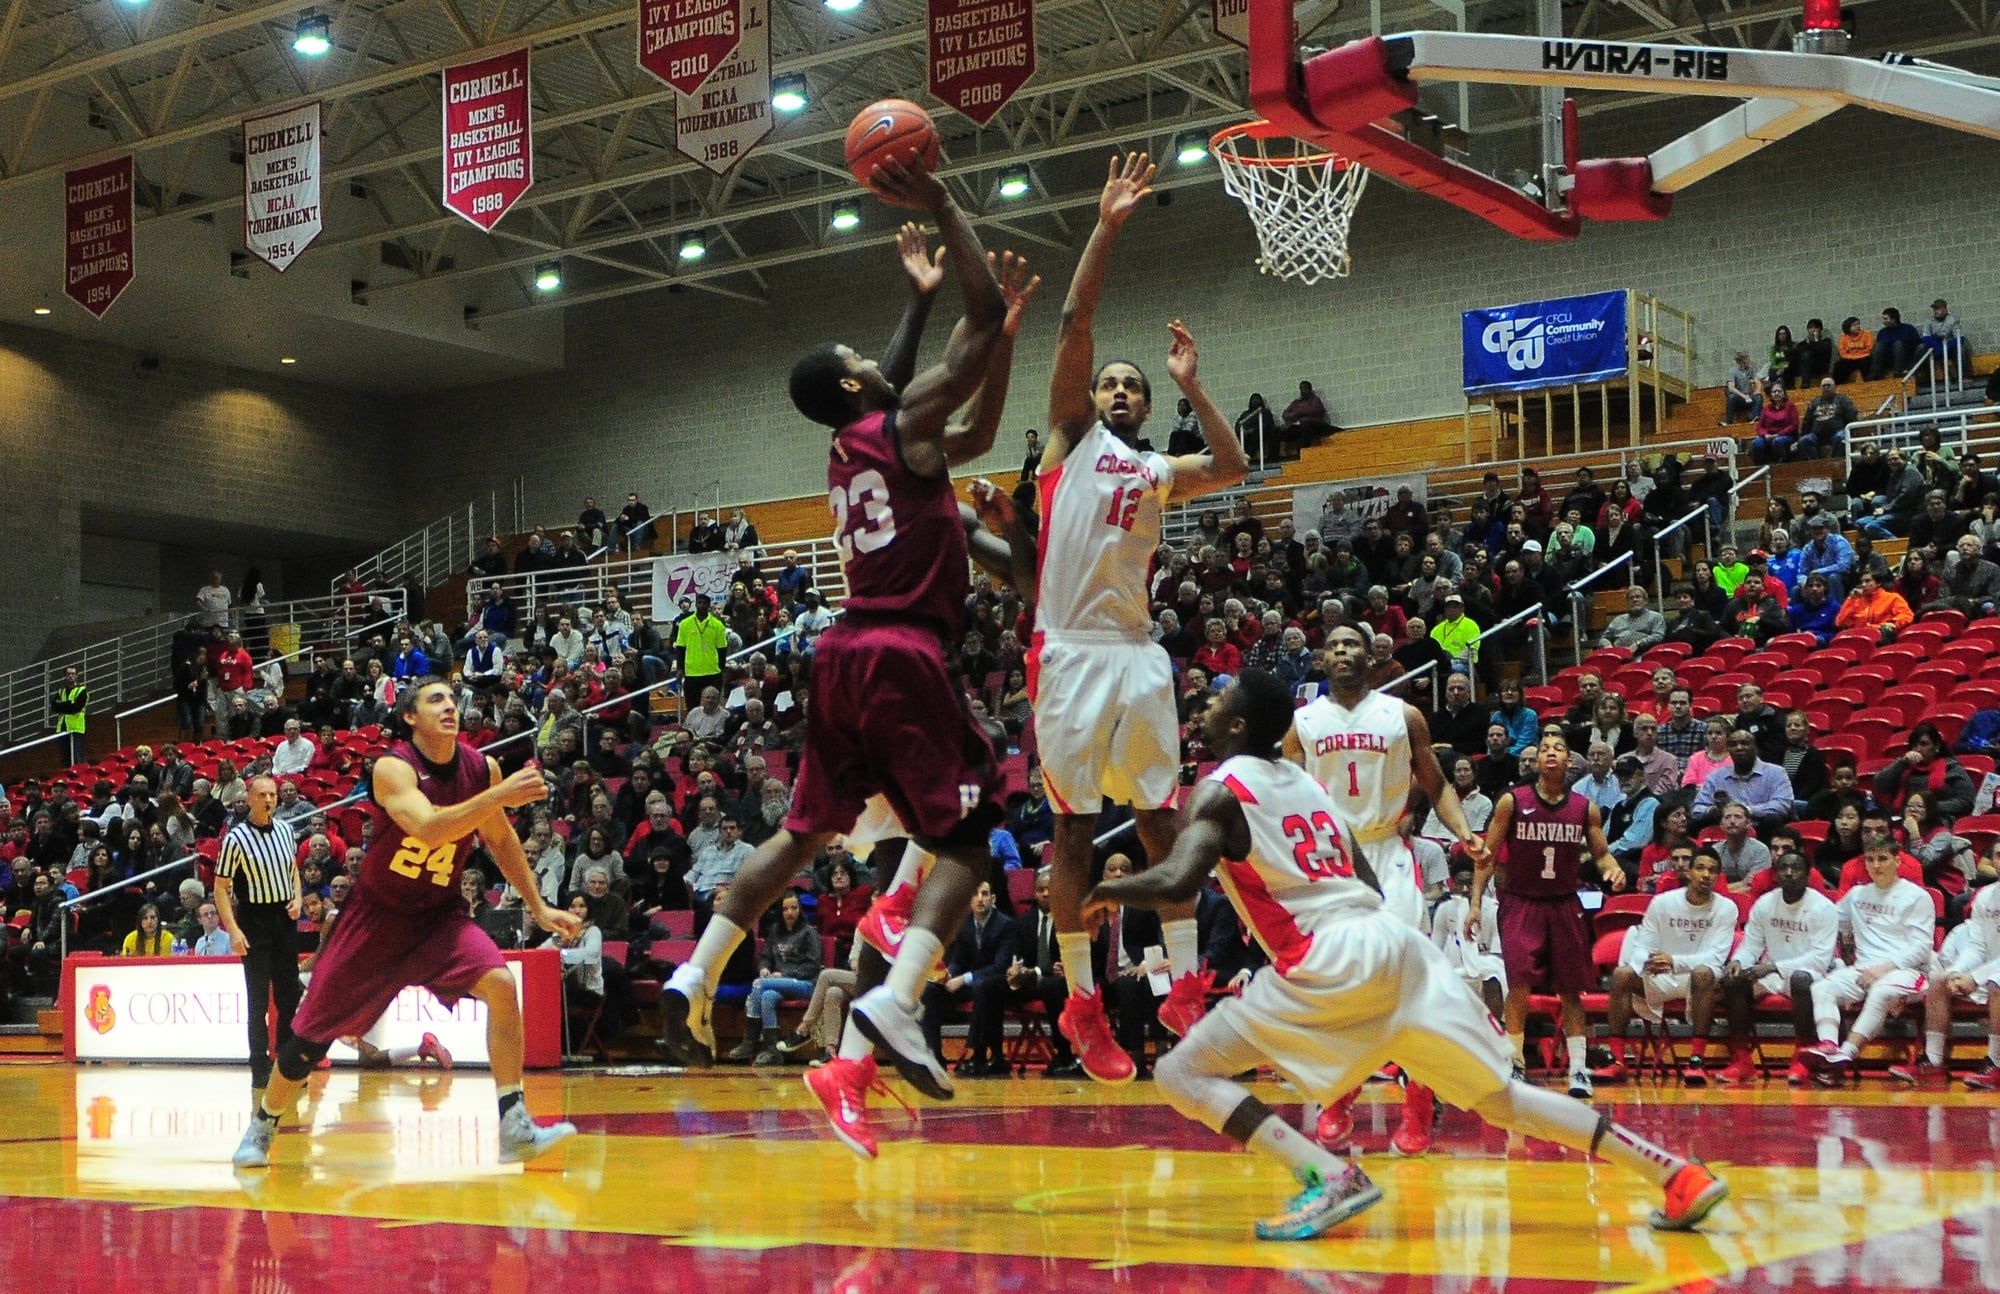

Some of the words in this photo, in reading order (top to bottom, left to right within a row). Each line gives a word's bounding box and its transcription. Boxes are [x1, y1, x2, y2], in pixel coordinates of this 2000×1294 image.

[648, 2, 670, 25] IVY
[935, 0, 1026, 32] BASKETBALL
[646, 10, 734, 54] CHAMPIONS
[940, 34, 962, 54] IVY
[968, 22, 1024, 49] LEAGUE
[671, 53, 708, 80] 2010
[936, 42, 1027, 82] CHAMPIONS
[450, 68, 523, 104] CORNELL
[702, 88, 738, 110] NCAA
[960, 83, 1002, 107] 2008
[468, 104, 504, 126] MEN'S
[678, 100, 766, 134] TOURNAMENT
[248, 122, 313, 154] CORNELL
[450, 119, 523, 149] BASKETBALL
[454, 151, 472, 168] IVY
[476, 138, 520, 164] LEAGUE
[704, 140, 738, 162] 1988
[266, 156, 296, 176] MEN'S
[451, 158, 524, 194] CHAMPIONS
[69, 172, 128, 203] CORNELL
[251, 168, 311, 194] BASKETBALL
[84, 205, 114, 224] MEN'S
[267, 194, 294, 214] NCAA
[472, 192, 503, 214] 1988
[70, 218, 126, 245] BASKETBALL
[248, 206, 318, 236] TOURNAMENT
[268, 241, 295, 260] 1954
[70, 252, 128, 284] CHAMPIONS
[87, 284, 111, 304] 1954
[1546, 312, 1572, 324] CFCU
[1546, 319, 1605, 334] Community
[1546, 335, 1571, 346] Credit
[1572, 332, 1598, 342] Union
[1710, 441, 1728, 454] WC
[829, 468, 896, 562] 23
[1106, 486, 1142, 532] 12
[1316, 733, 1388, 756] CORNELL
[1348, 762, 1359, 796] 1
[1282, 810, 1354, 882] 23
[1516, 822, 1582, 843] HARVARD
[390, 836, 456, 887] 24
[1541, 846, 1556, 879] 1
[128, 992, 249, 1026] CORNEL
